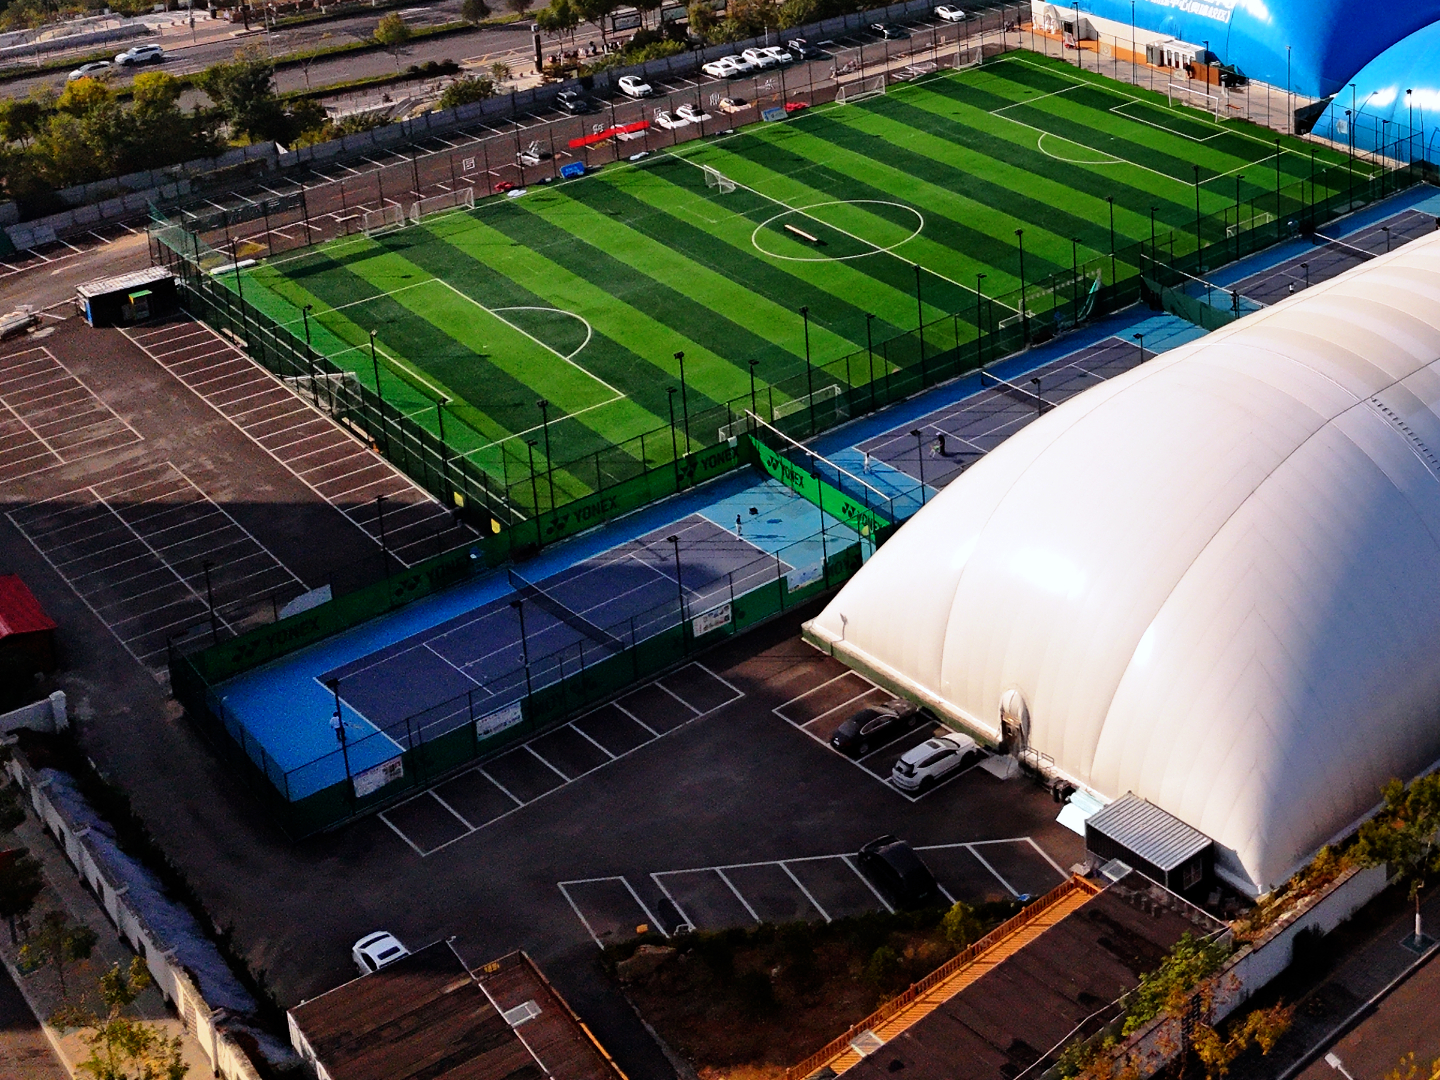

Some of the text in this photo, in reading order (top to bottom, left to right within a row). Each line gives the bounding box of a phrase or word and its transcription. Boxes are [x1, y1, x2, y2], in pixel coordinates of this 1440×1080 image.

[702, 446, 739, 471] YONEX
[781, 464, 804, 488] YONEX
[573, 495, 617, 523] YONEX
[266, 616, 320, 647] YONEX
